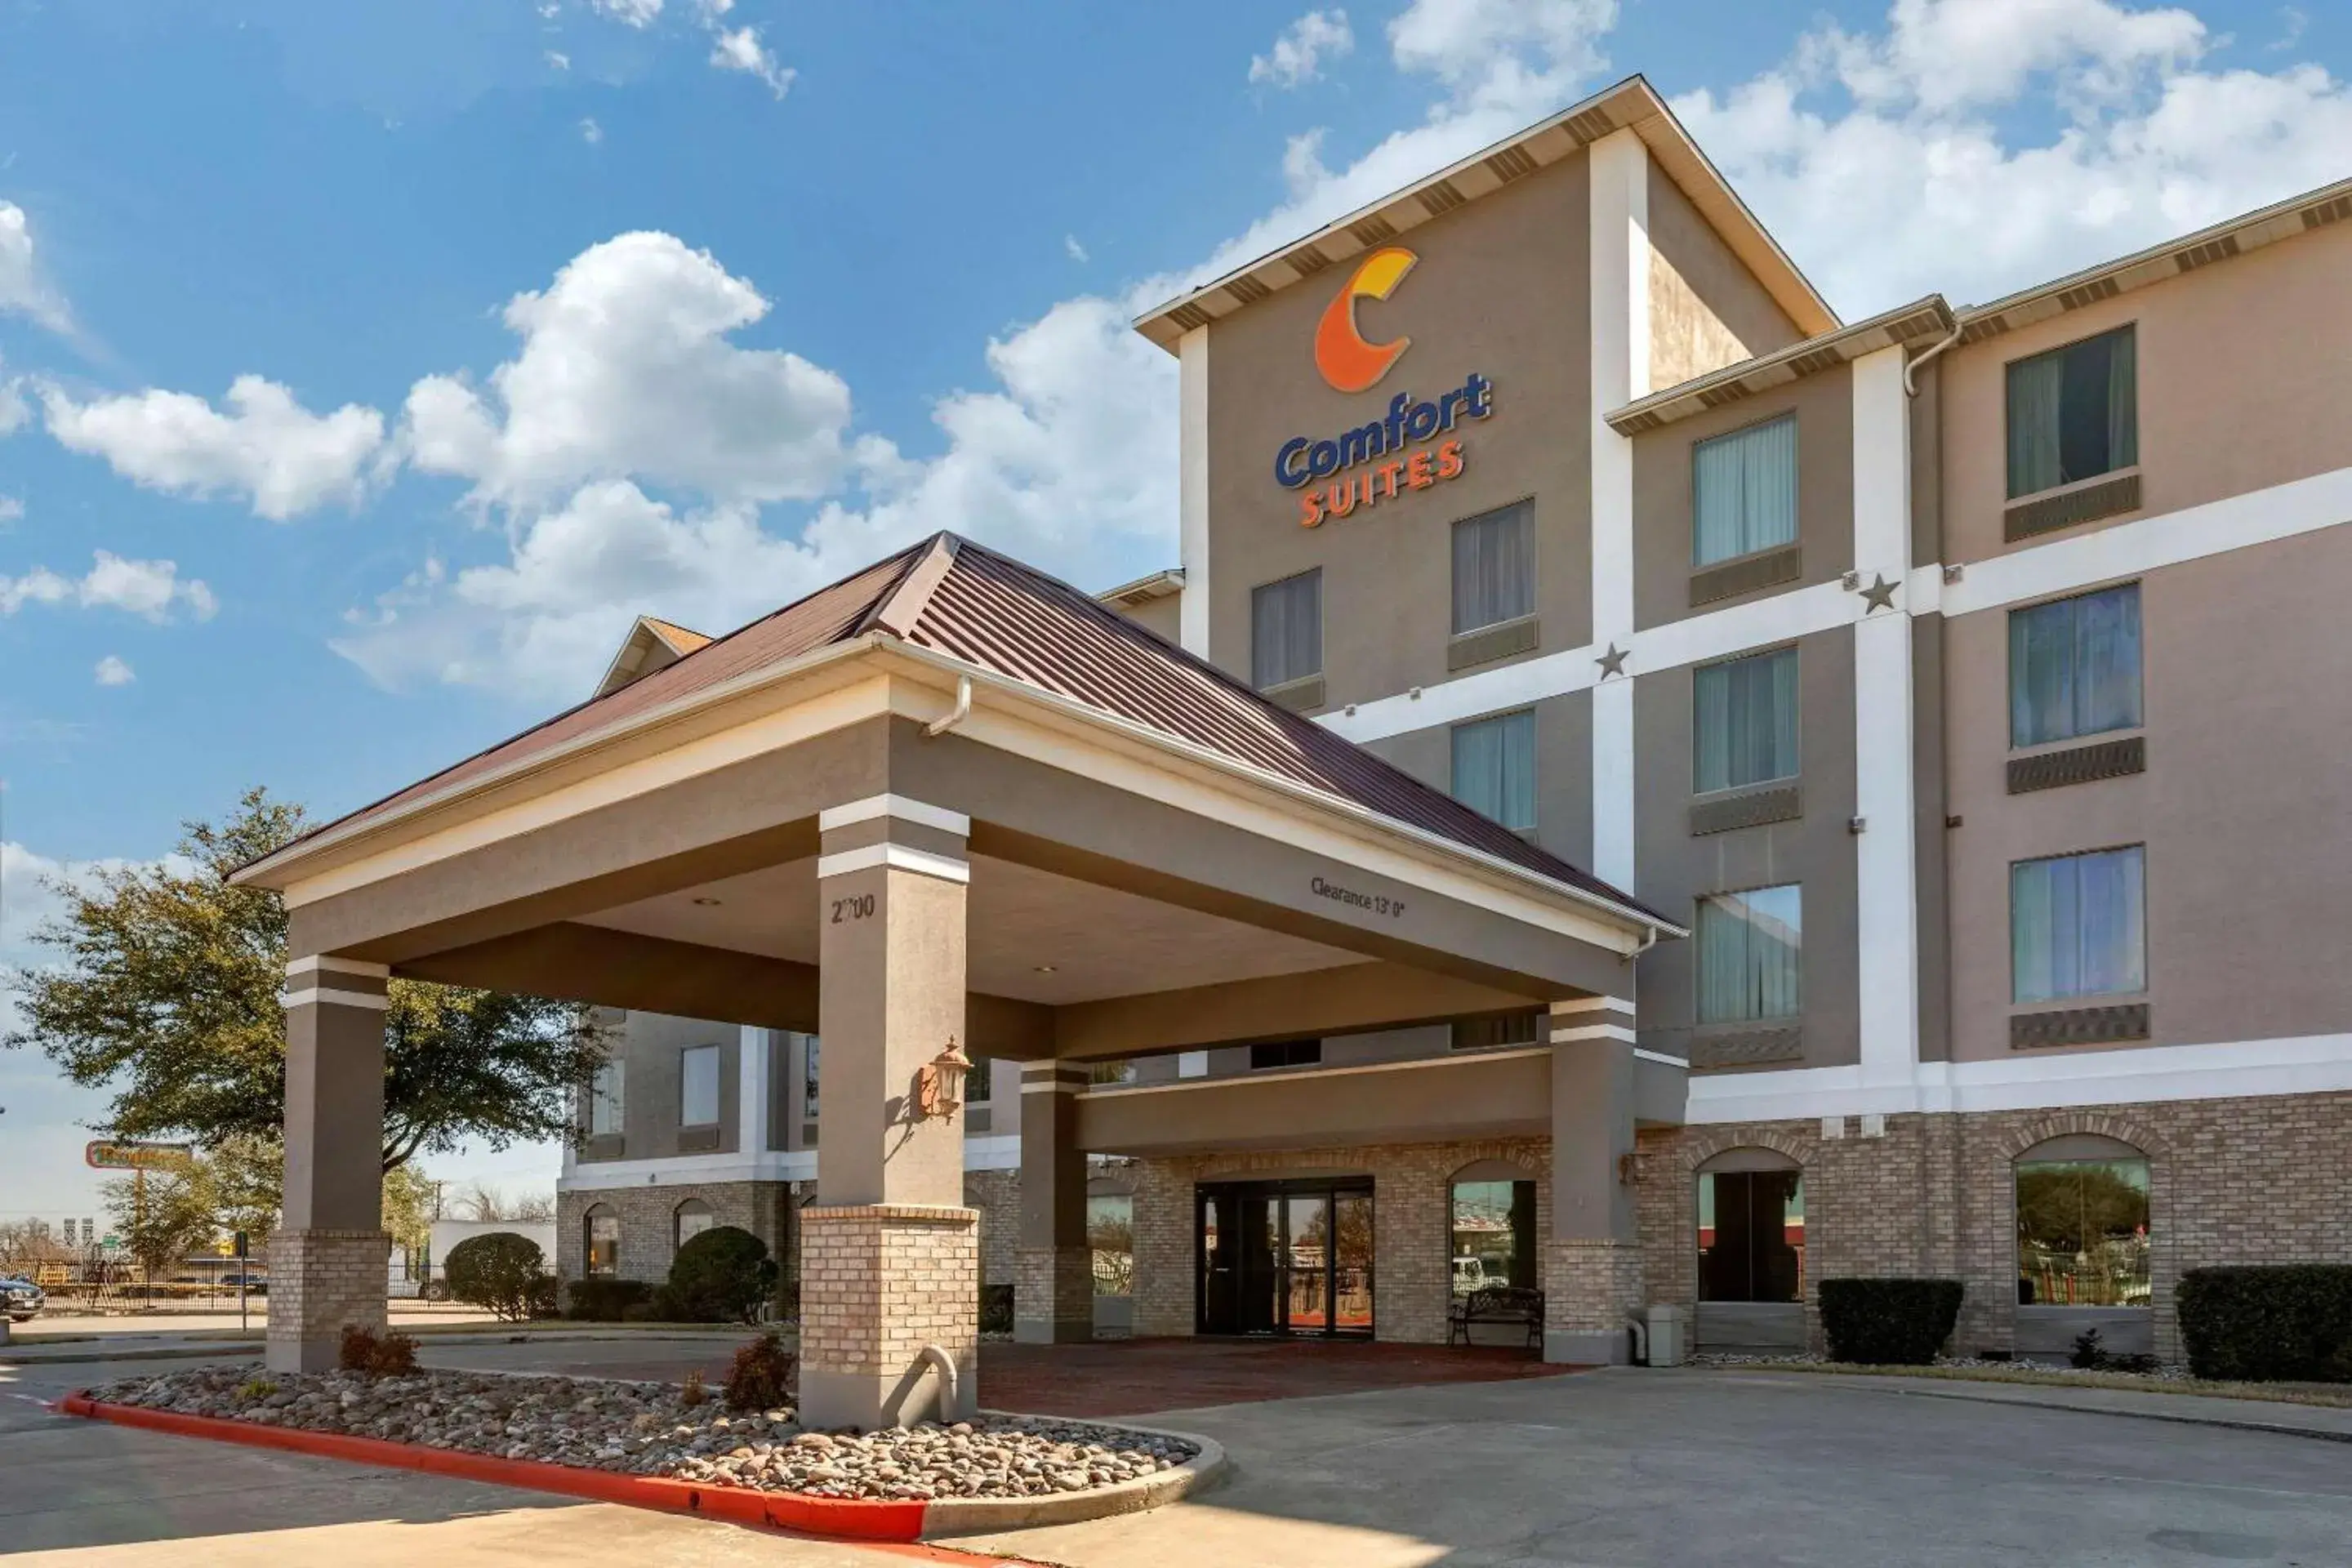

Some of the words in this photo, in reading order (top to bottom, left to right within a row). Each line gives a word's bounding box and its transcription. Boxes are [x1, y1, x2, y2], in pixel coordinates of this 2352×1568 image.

[1275, 372, 1491, 490] Comfort
[1299, 440, 1465, 529] SUITES
[1311, 876, 1373, 910] Clearance
